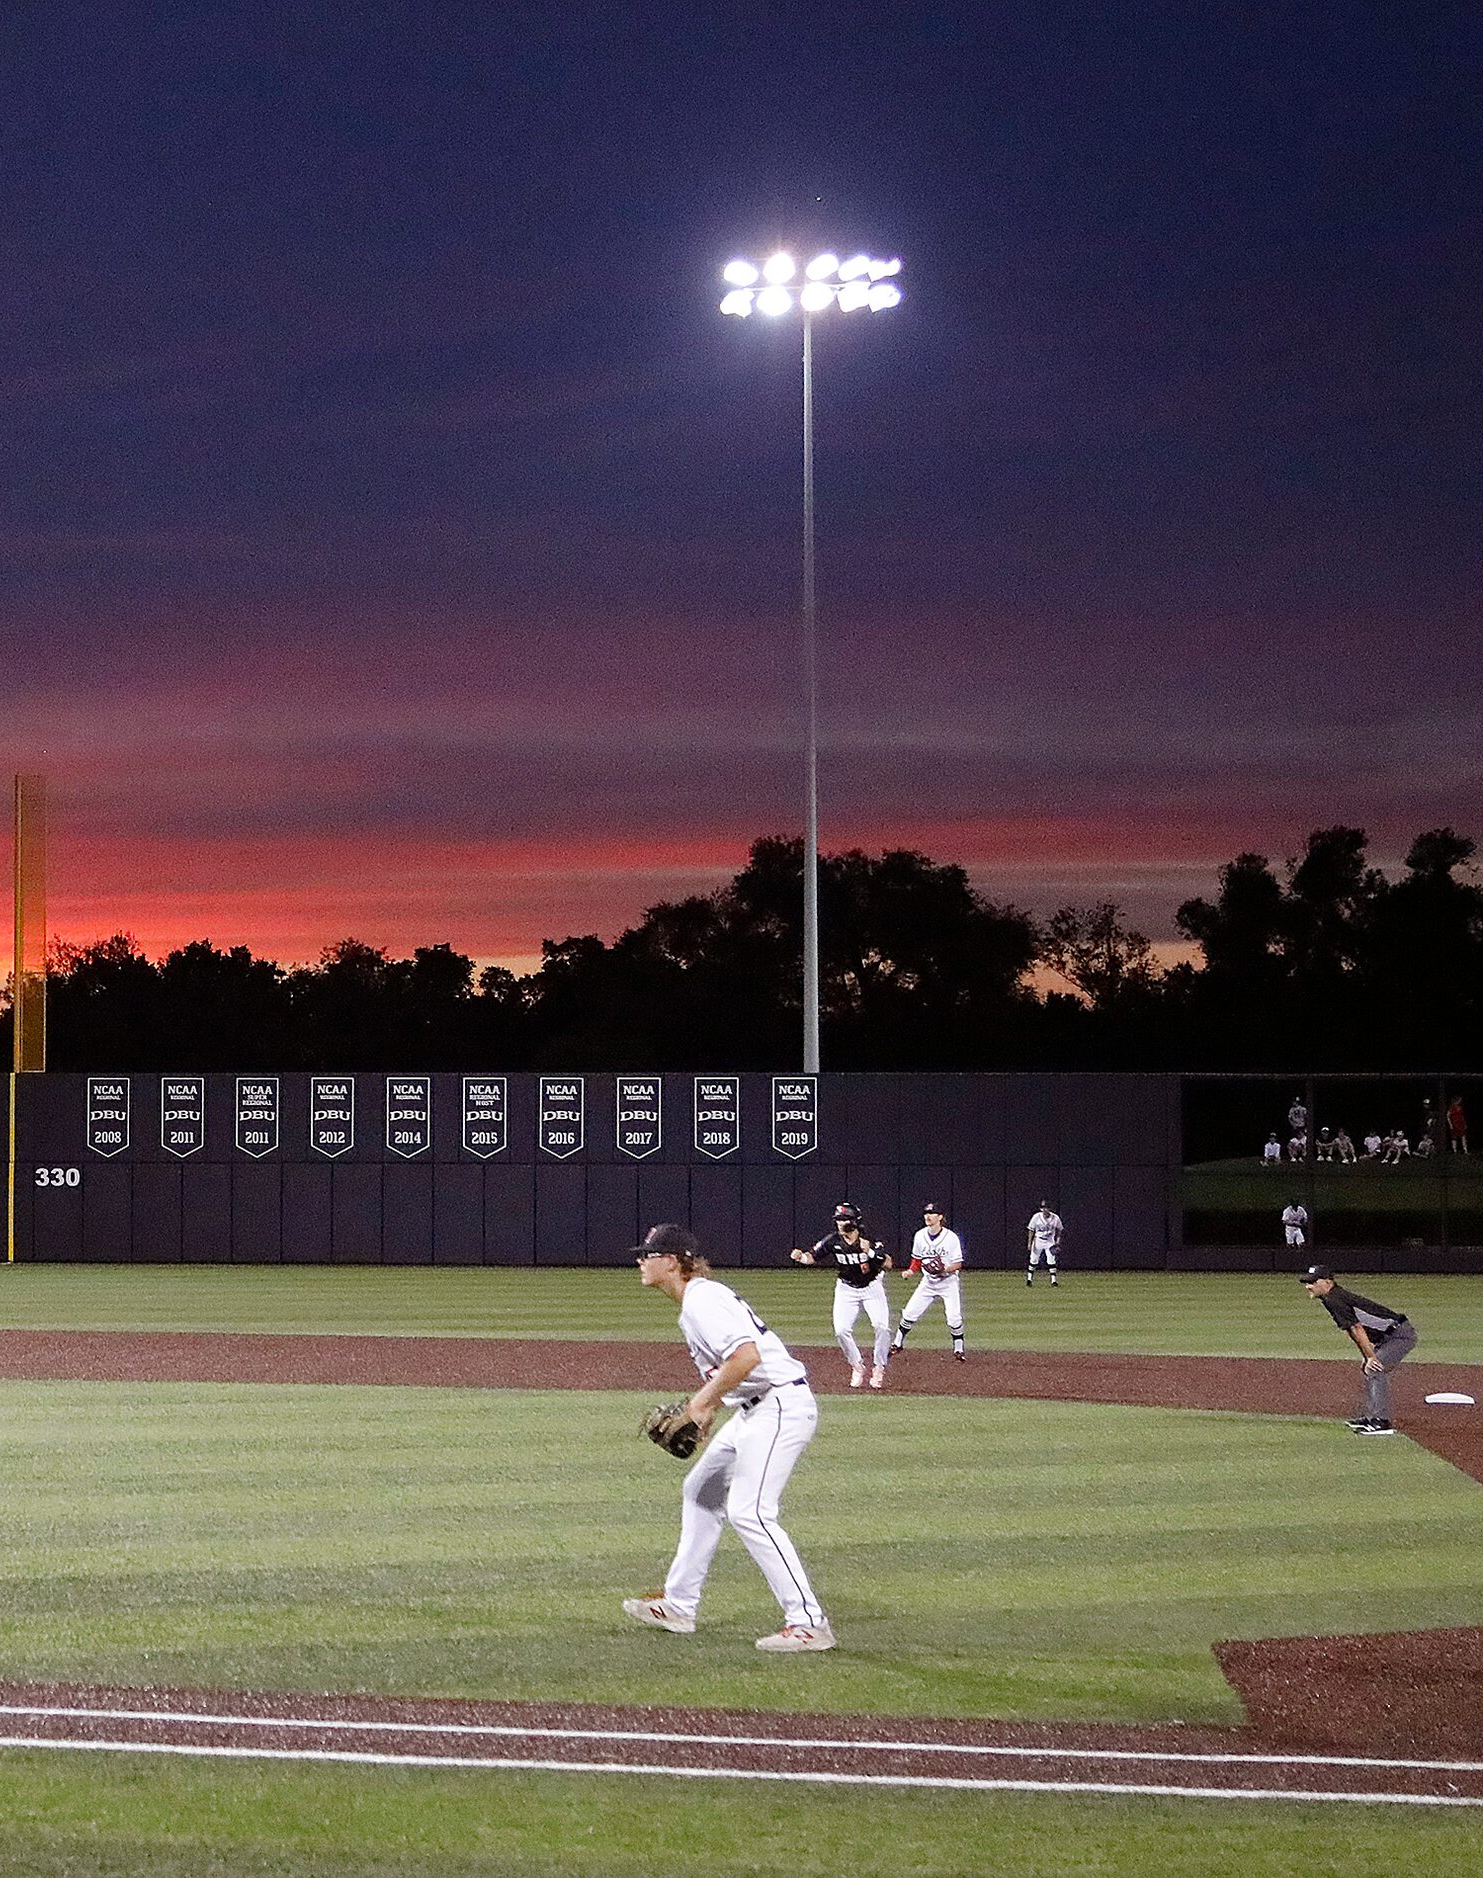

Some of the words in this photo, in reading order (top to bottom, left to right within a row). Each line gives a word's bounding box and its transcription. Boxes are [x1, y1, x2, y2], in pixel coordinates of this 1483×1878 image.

[94, 1086, 123, 1095] NCAA
[168, 1085, 197, 1095] NCAA
[243, 1086, 272, 1095] NCAA
[317, 1085, 347, 1095] NCAA
[393, 1085, 423, 1095] NCAA
[470, 1085, 500, 1095] NCAA
[546, 1085, 577, 1095] NCAA
[623, 1085, 654, 1095] NCAA
[701, 1085, 732, 1095] NCAA
[779, 1085, 810, 1095] NCAA
[91, 1110, 126, 1120] DBU
[165, 1110, 200, 1120] DBU
[240, 1111, 275, 1121] DBU
[315, 1110, 350, 1120] DBU
[390, 1110, 426, 1120] DBU
[466, 1111, 503, 1121] DBU
[543, 1111, 580, 1121] DBU
[620, 1111, 657, 1121] DBU
[698, 1111, 735, 1121] DBU
[776, 1111, 813, 1121] DBU
[95, 1131, 121, 1143] 2008
[171, 1132, 194, 1143] 2011
[246, 1132, 269, 1143] 2011
[320, 1132, 346, 1143] 2012
[395, 1132, 421, 1143] 2014
[472, 1132, 497, 1144] 2015
[548, 1132, 575, 1144] 2016
[626, 1132, 652, 1144] 2017
[703, 1132, 730, 1144] 2018
[782, 1133, 808, 1144] 2019
[34, 1167, 81, 1187] 330
